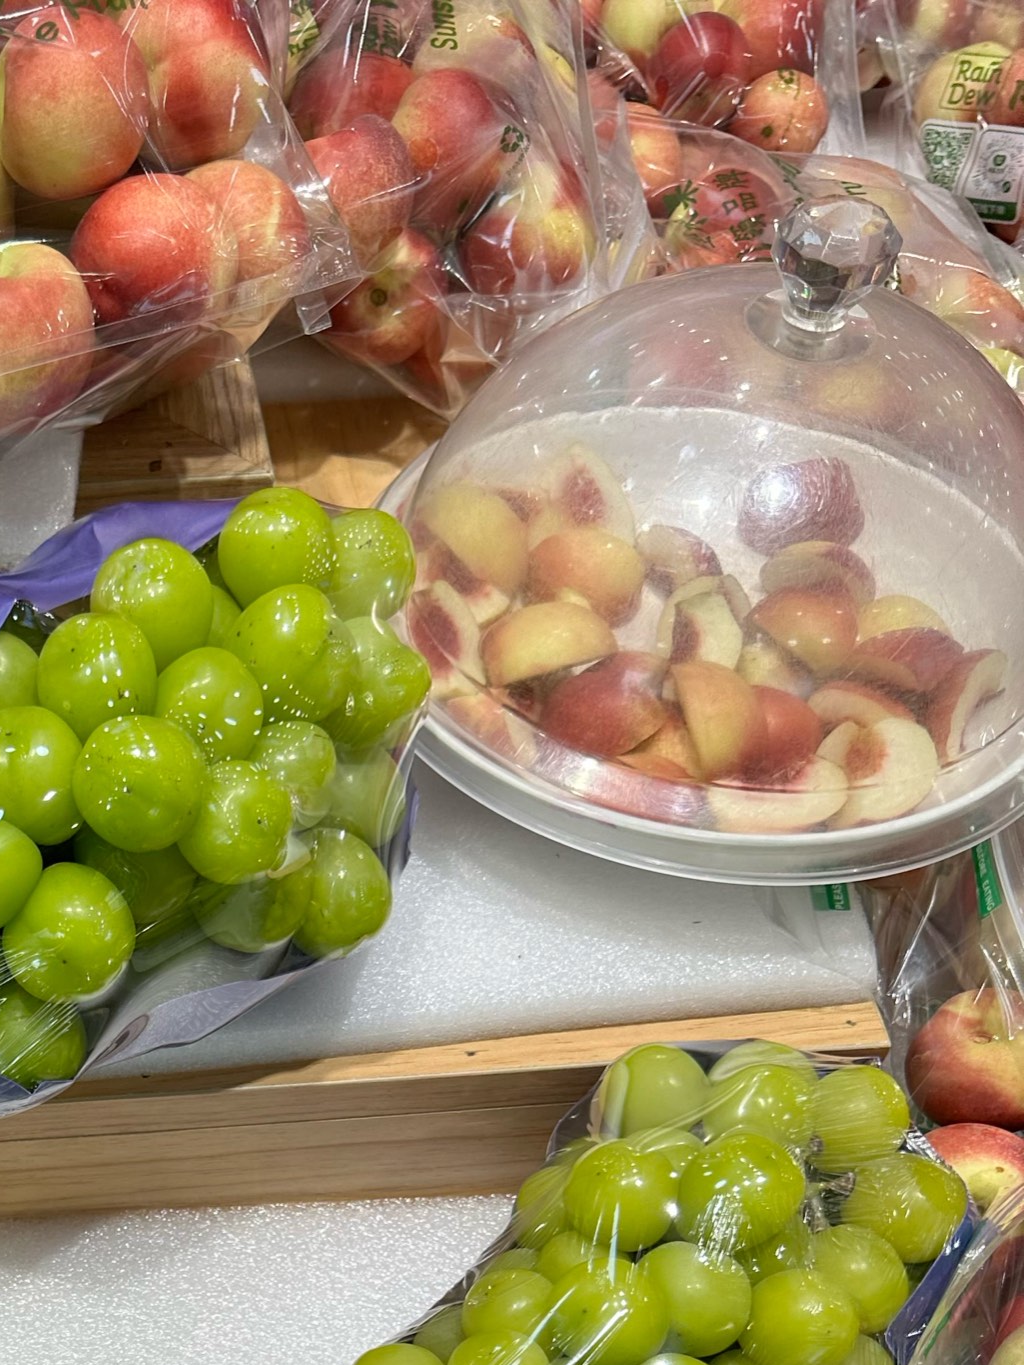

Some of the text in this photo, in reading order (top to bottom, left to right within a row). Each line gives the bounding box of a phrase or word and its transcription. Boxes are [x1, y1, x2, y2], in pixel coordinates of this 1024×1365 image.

[956, 61, 1003, 84] Rain
[947, 83, 995, 105] Dew
[982, 879, 996, 912] EATING
